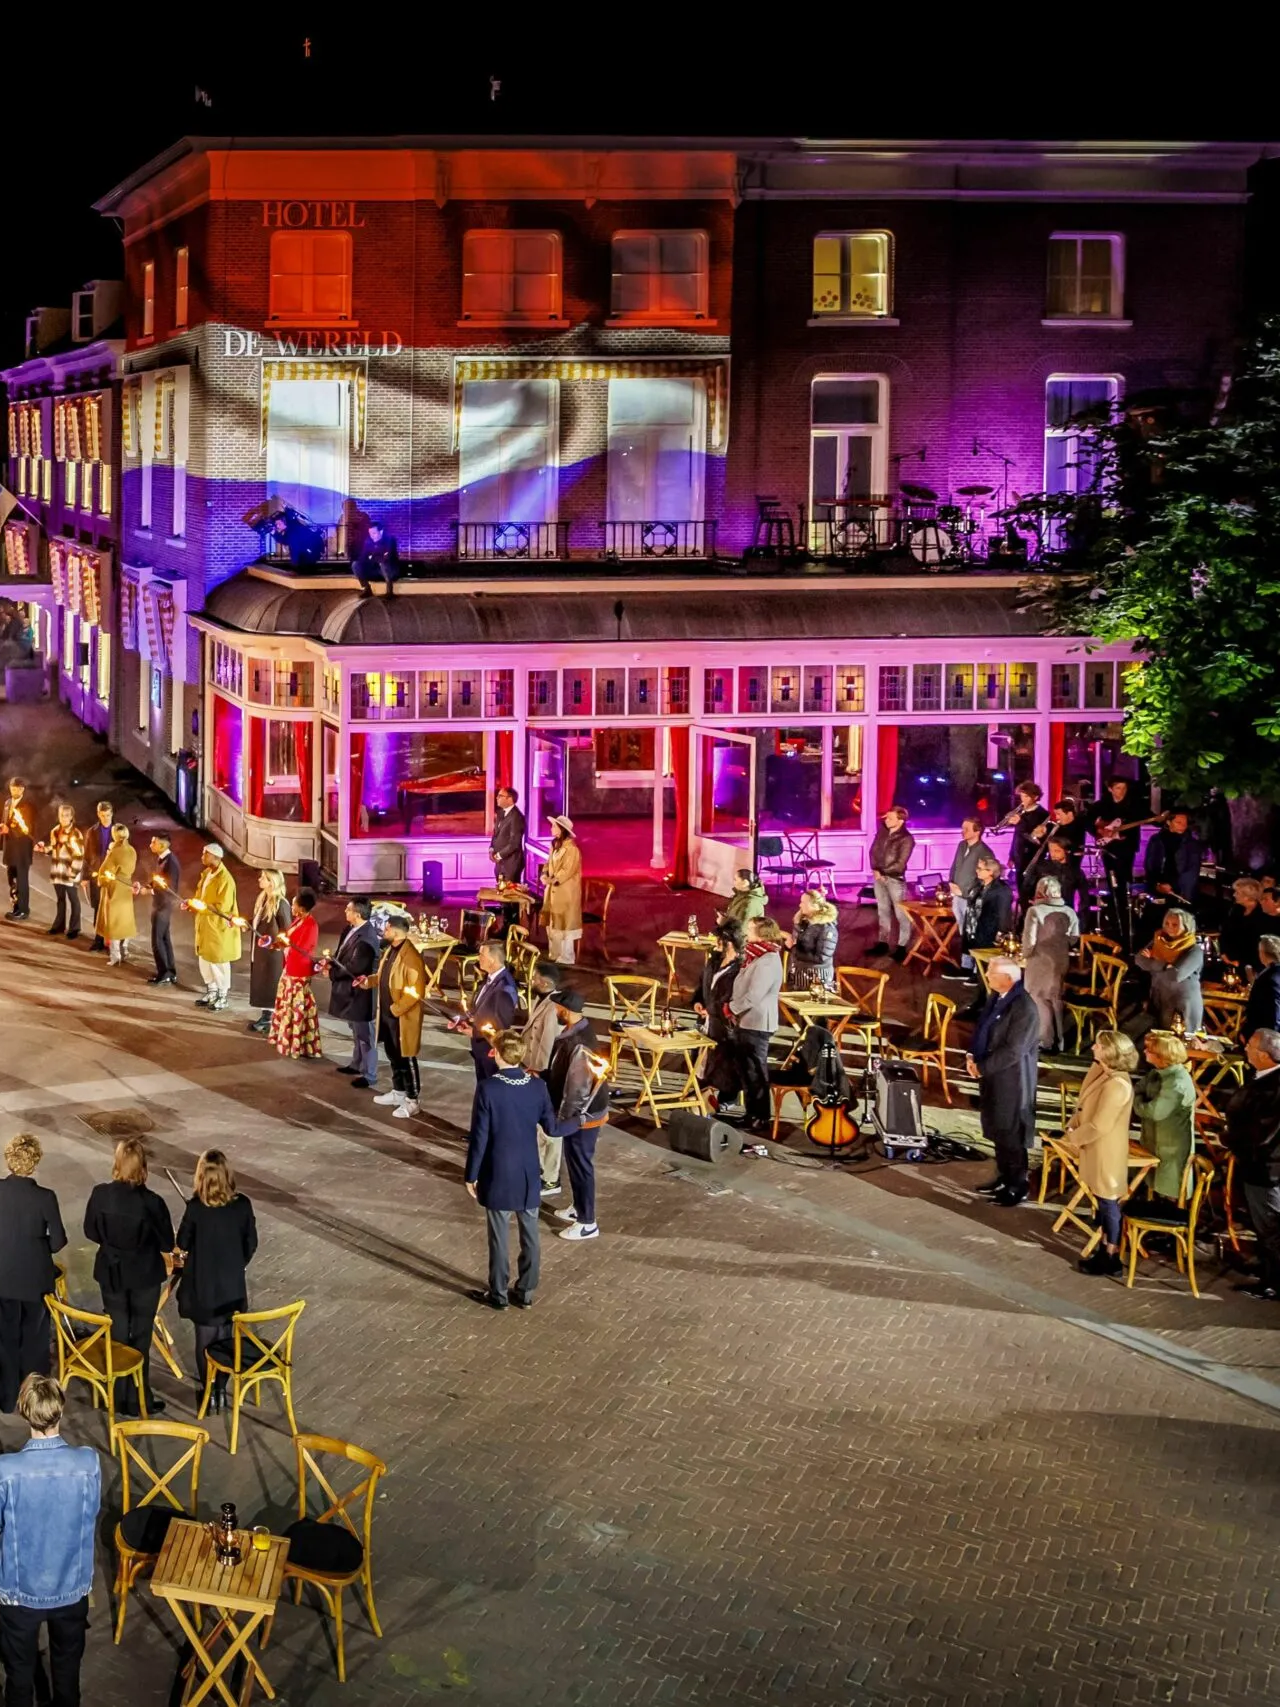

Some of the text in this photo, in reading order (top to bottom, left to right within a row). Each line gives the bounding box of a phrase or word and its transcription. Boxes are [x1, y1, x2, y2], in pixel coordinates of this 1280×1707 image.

[261, 201, 366, 227] HOTEL
[223, 331, 402, 356] DE WERELD
